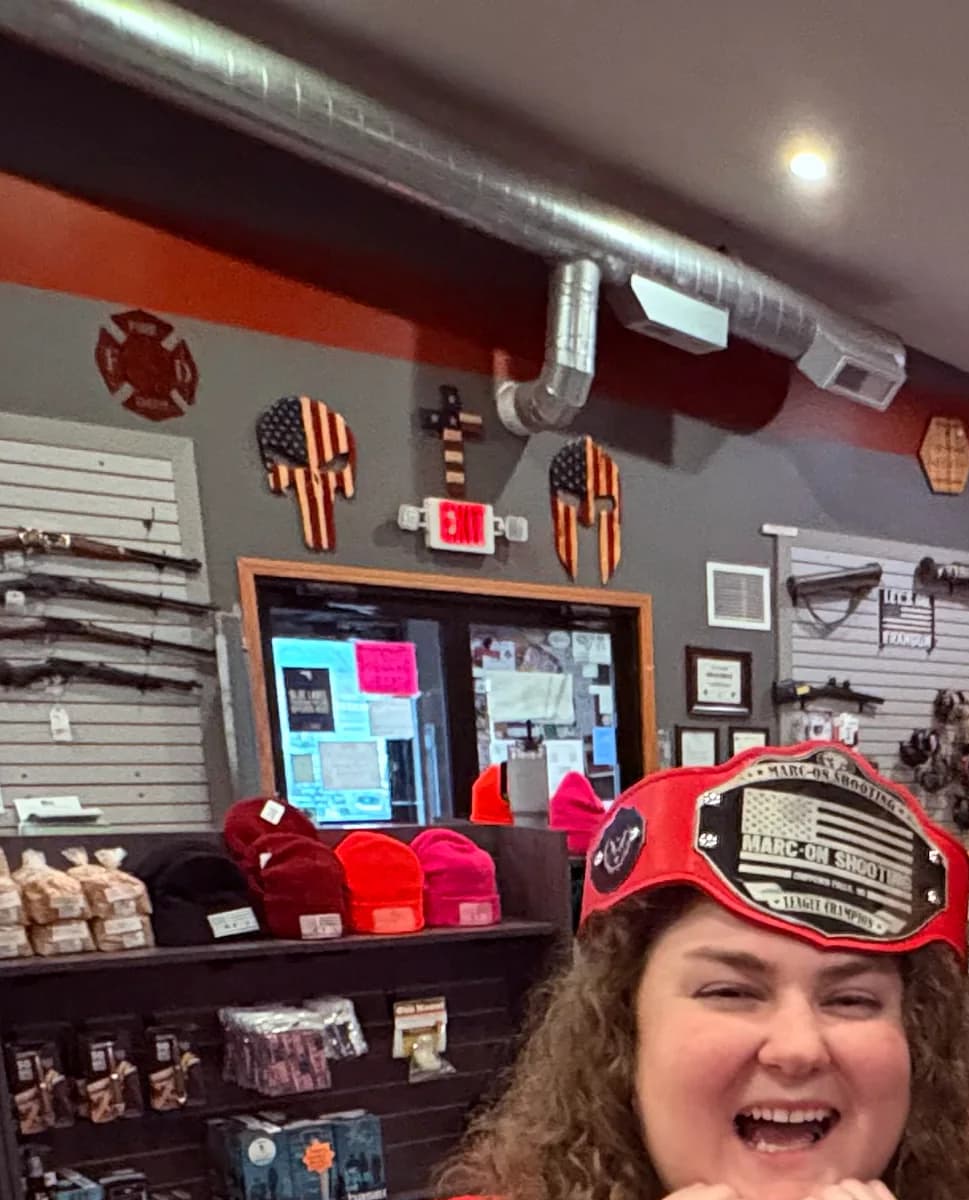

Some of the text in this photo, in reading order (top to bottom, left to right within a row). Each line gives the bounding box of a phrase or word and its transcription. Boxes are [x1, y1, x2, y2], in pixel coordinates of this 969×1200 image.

[440, 502, 484, 547] EXIT
[768, 764, 896, 811] MARC-ON SHOOTING
[741, 834, 913, 893] MARC-ON SHOOTING
